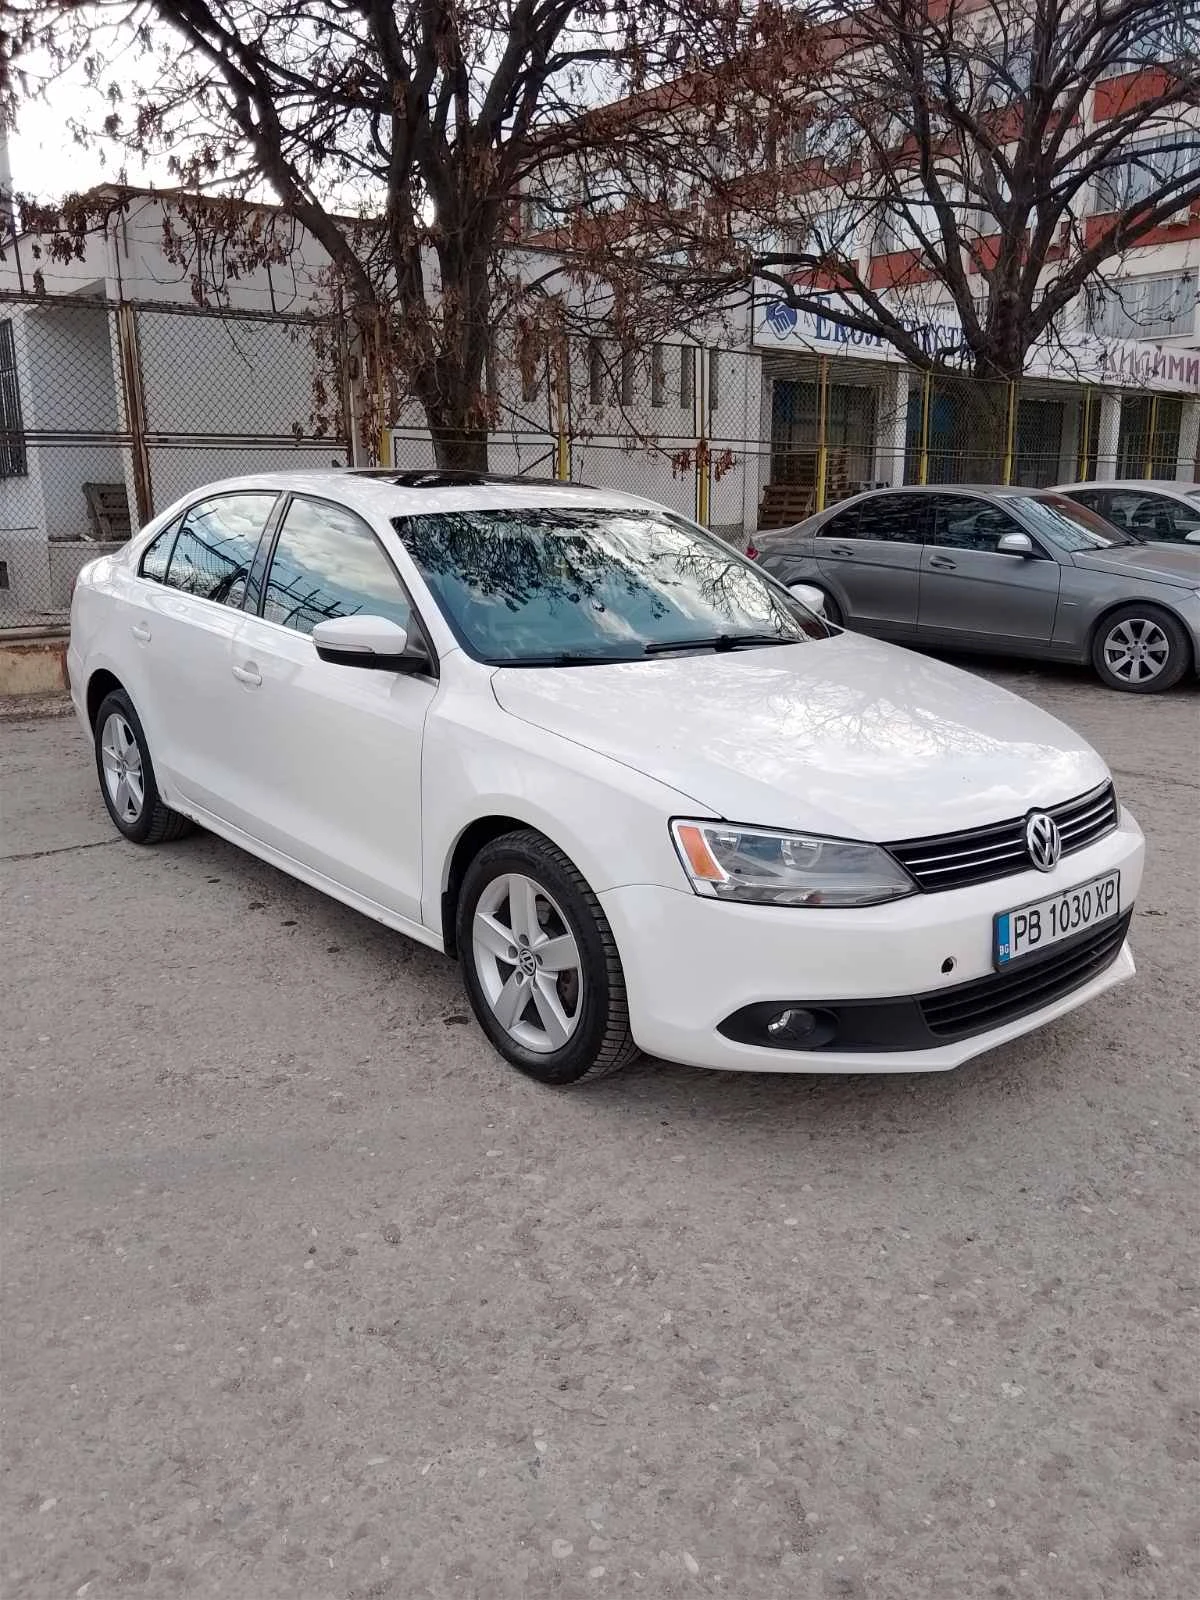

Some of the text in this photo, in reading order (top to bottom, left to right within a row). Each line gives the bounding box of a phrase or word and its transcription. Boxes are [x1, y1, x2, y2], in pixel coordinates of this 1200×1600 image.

[1014, 879, 1115, 951] PB 1030 XP
[999, 942, 1010, 956] BG
